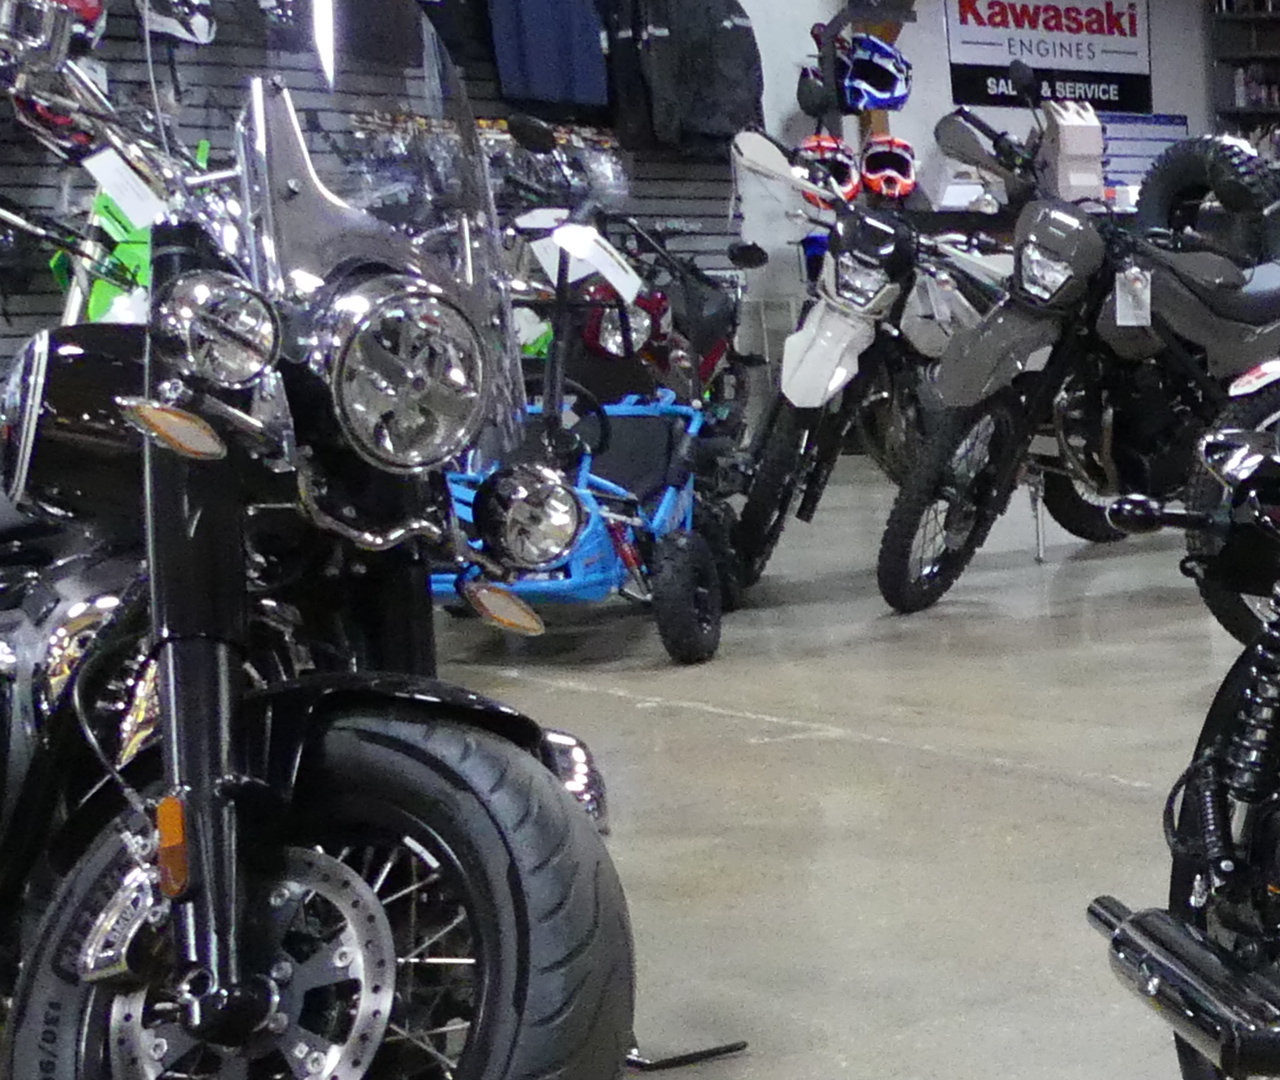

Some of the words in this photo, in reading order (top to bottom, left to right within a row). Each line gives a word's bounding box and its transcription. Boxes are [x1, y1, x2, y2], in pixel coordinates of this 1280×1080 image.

[958, 0, 1138, 37] Kawasaki
[1007, 38, 1096, 60] ENGINES
[1041, 81, 1052, 97] &
[1056, 82, 1119, 100] SERVICE
